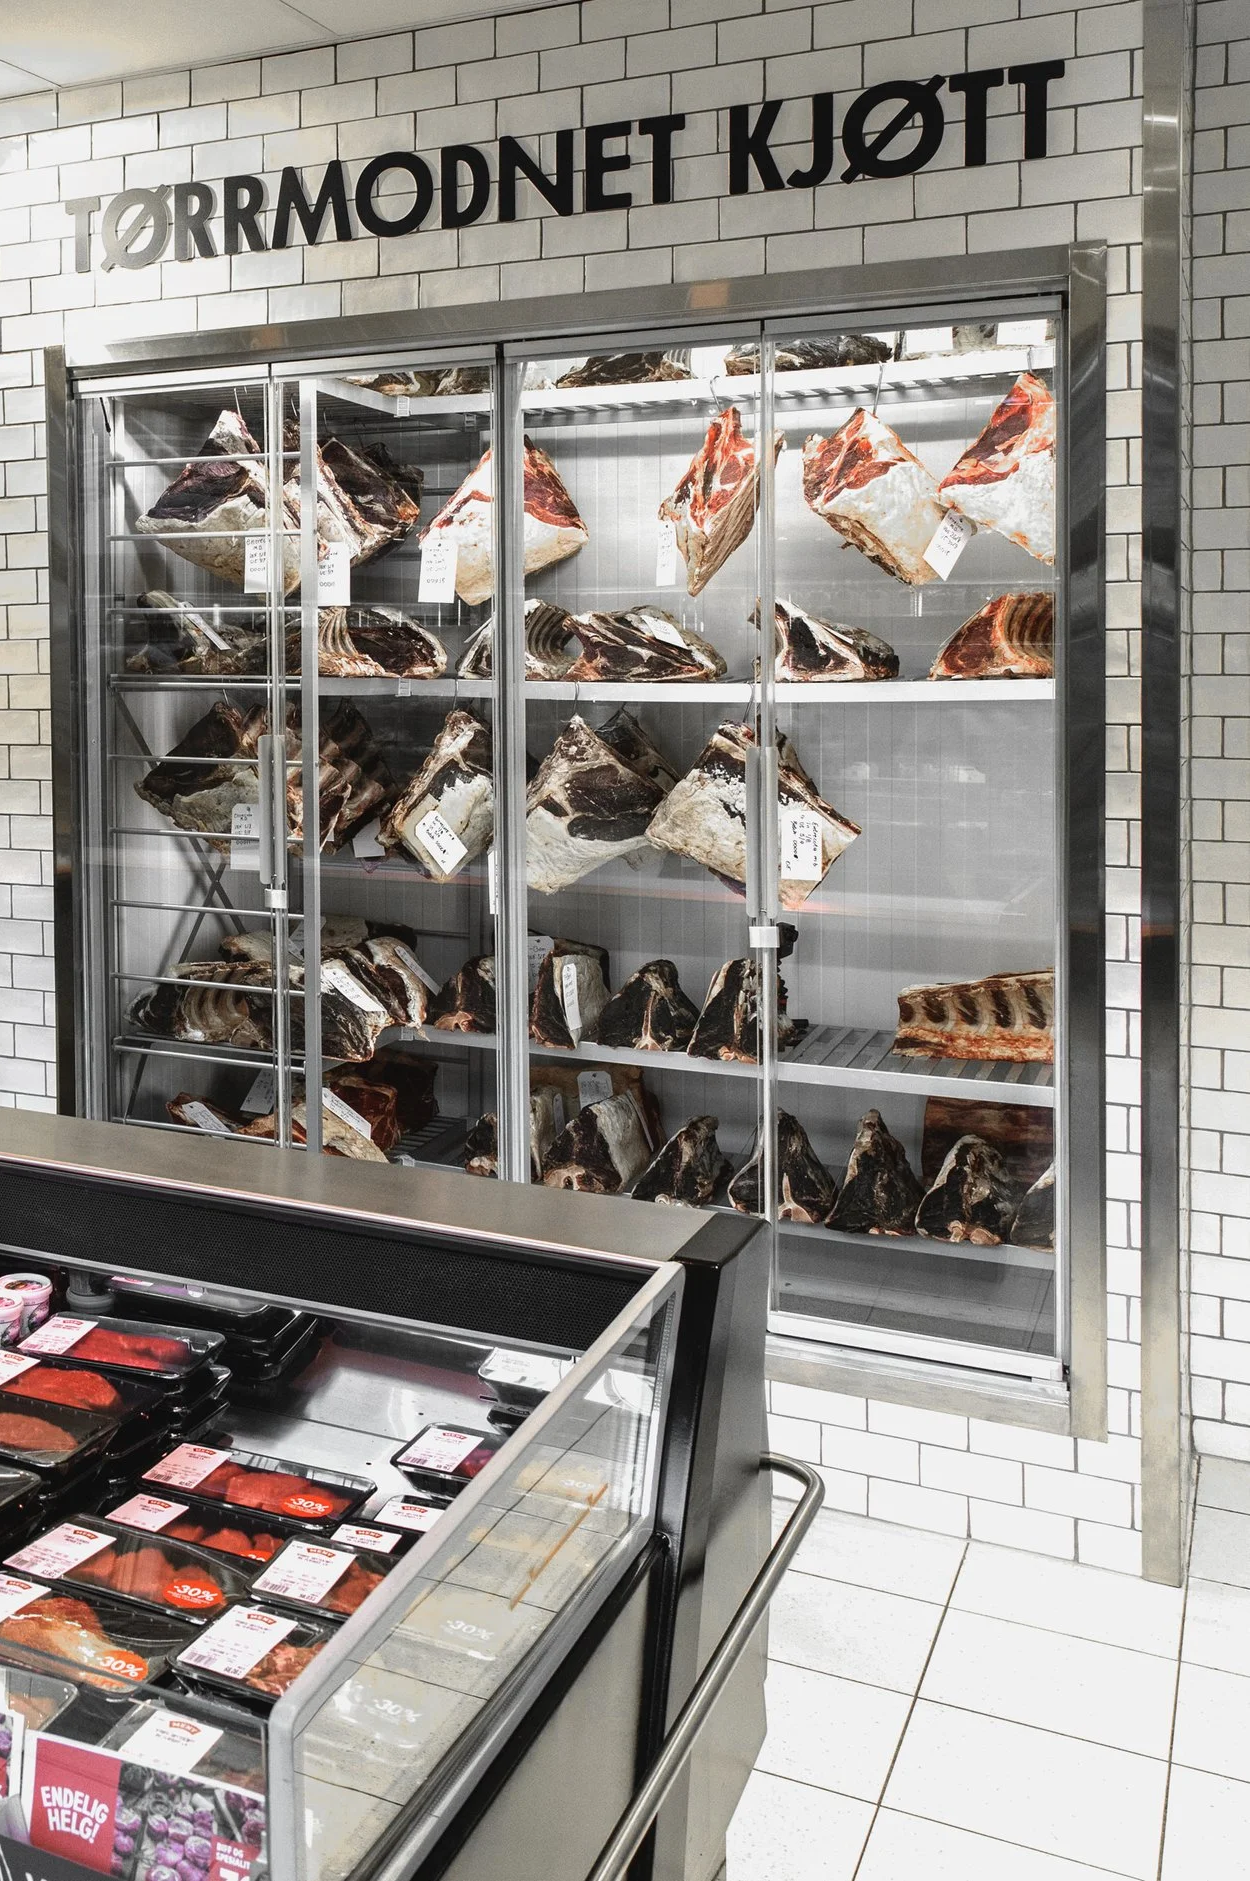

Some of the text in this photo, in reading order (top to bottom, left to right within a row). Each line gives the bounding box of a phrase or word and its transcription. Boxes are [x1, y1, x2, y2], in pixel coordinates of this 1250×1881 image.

[65, 60, 1065, 272] TØRRMODNET KJØTT
[290, 1498, 329, 1513] -30%
[173, 1583, 220, 1603] -30%
[446, 1618, 495, 1641] -30%
[96, 1655, 144, 1678] -30%
[40, 1785, 110, 1825] ENDELIG
[47, 1808, 100, 1844] HELG!
[216, 1842, 244, 1858] BIFF OG
